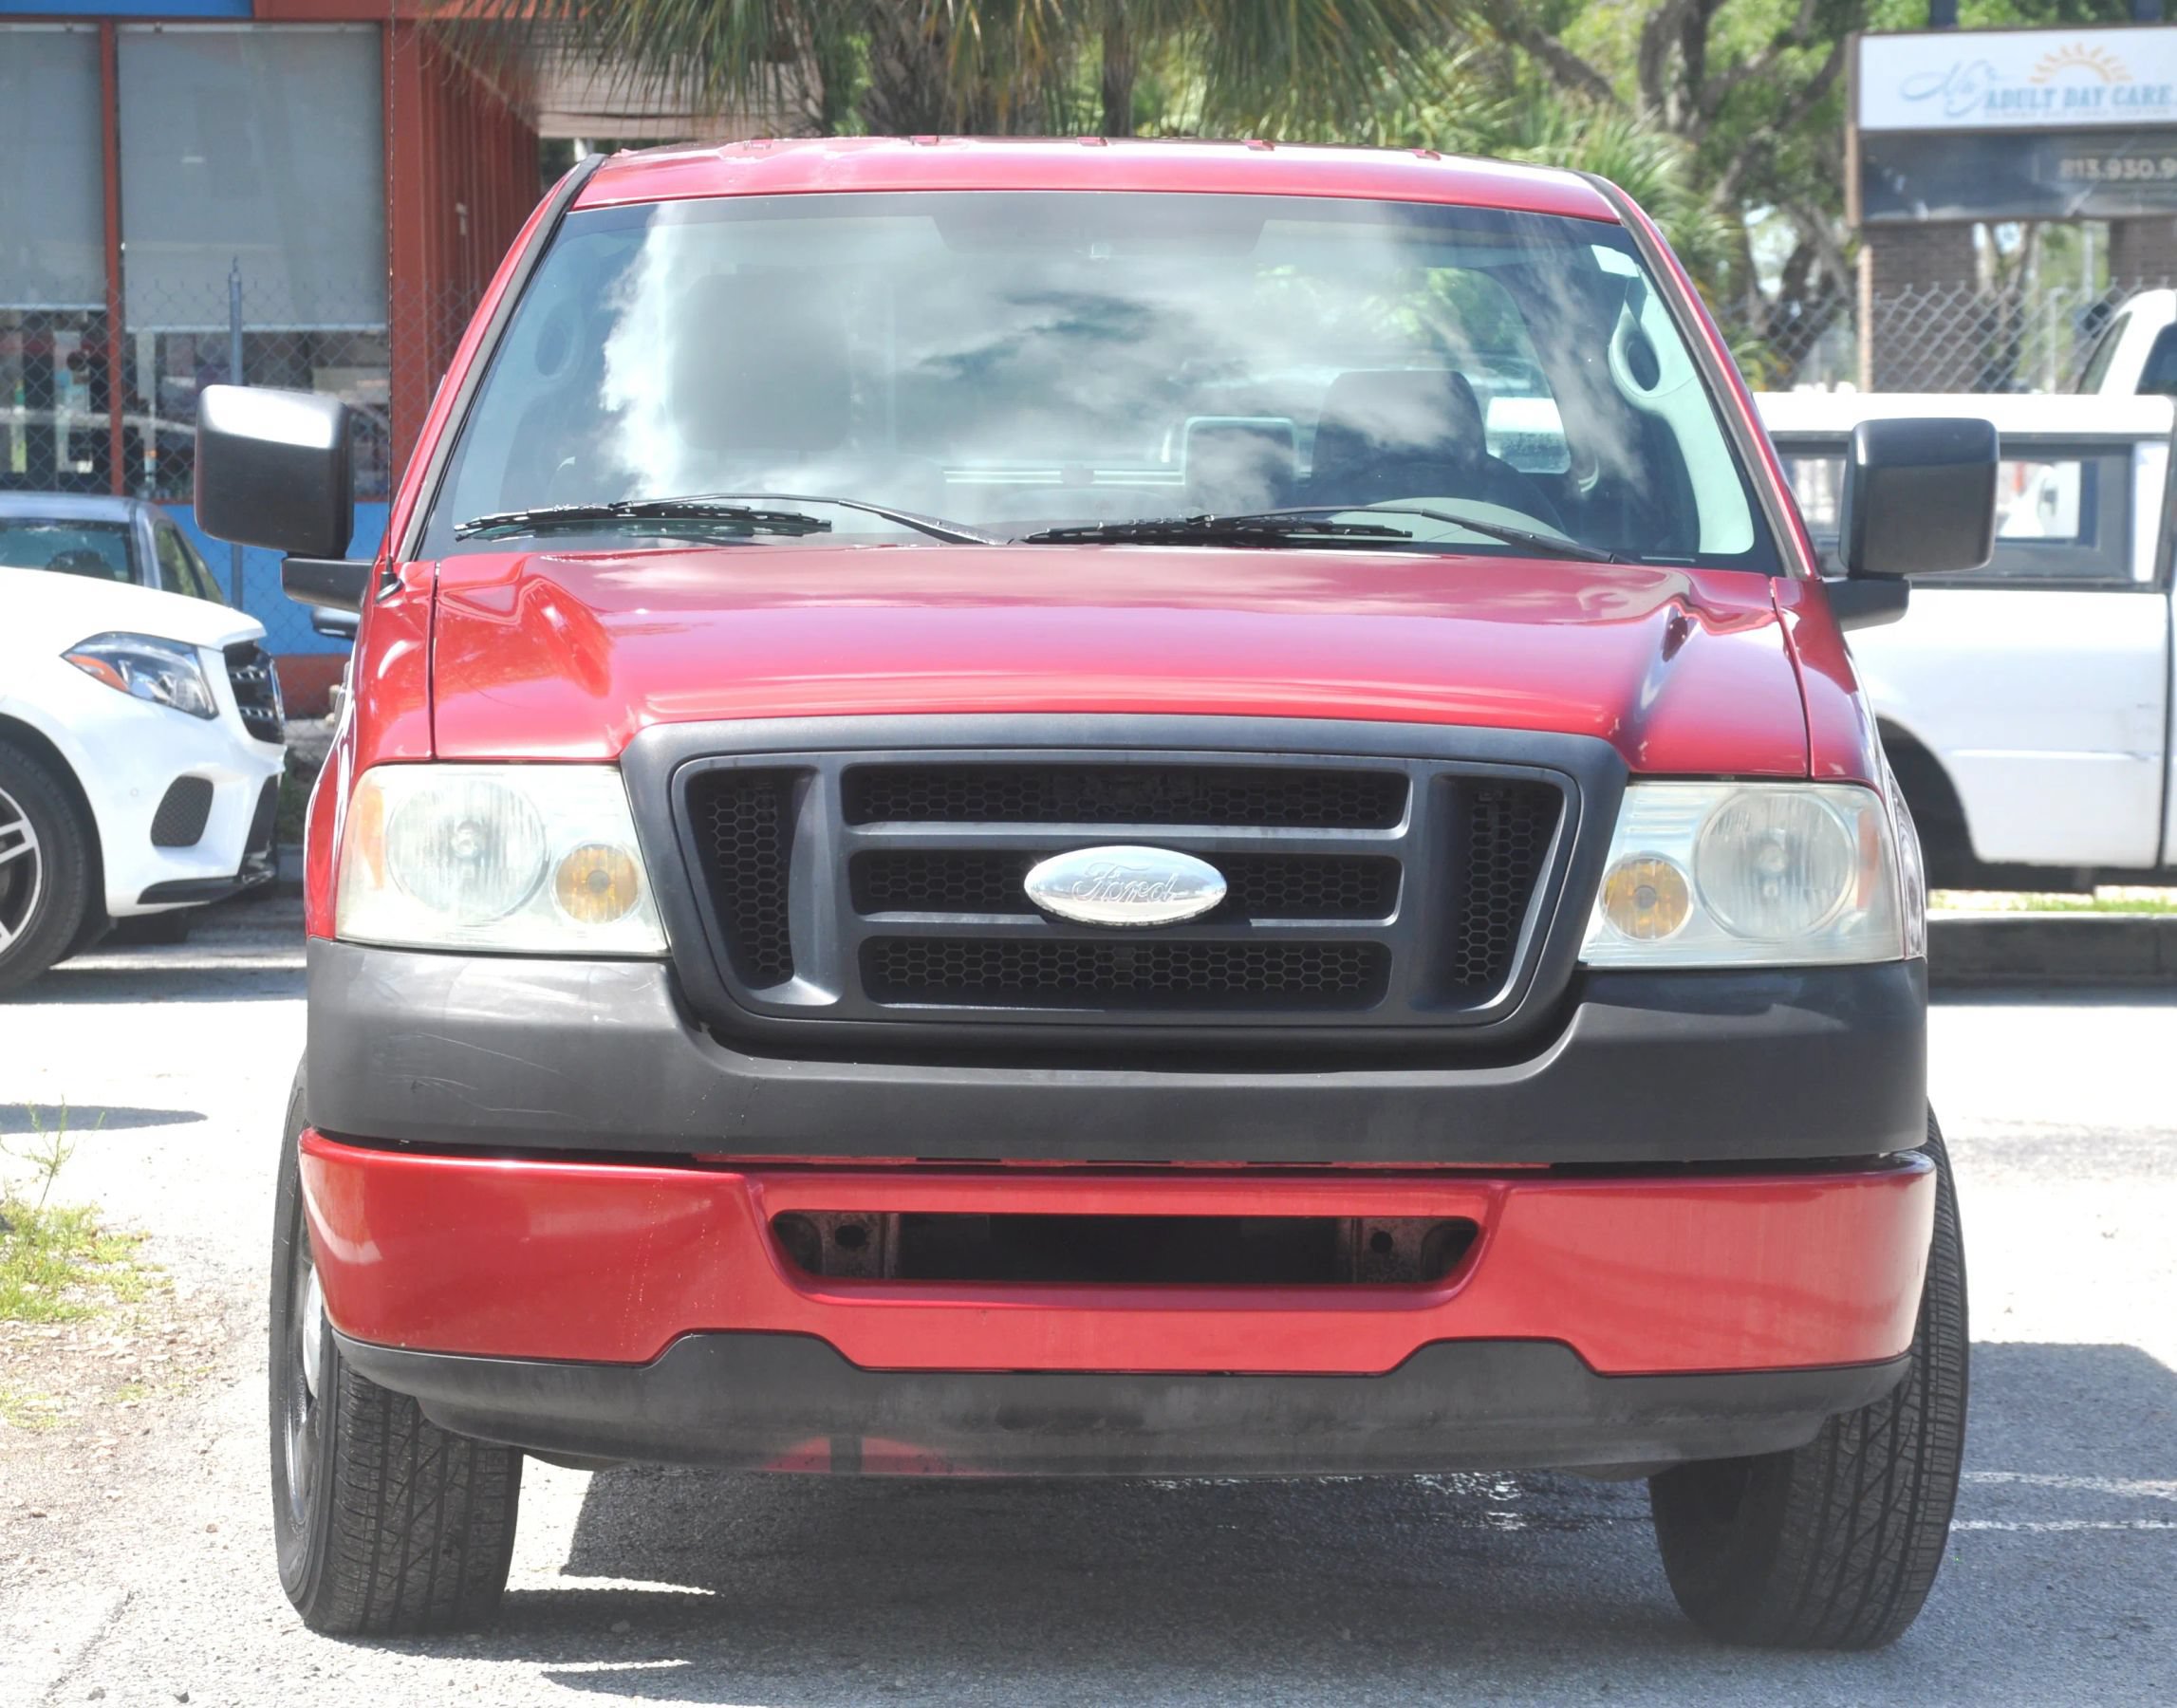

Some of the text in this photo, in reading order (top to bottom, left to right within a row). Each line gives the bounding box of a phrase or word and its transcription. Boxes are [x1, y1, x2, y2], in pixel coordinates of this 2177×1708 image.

[1984, 84, 2173, 110] ADULT DAY CARE
[1071, 862, 1180, 903] Ford
